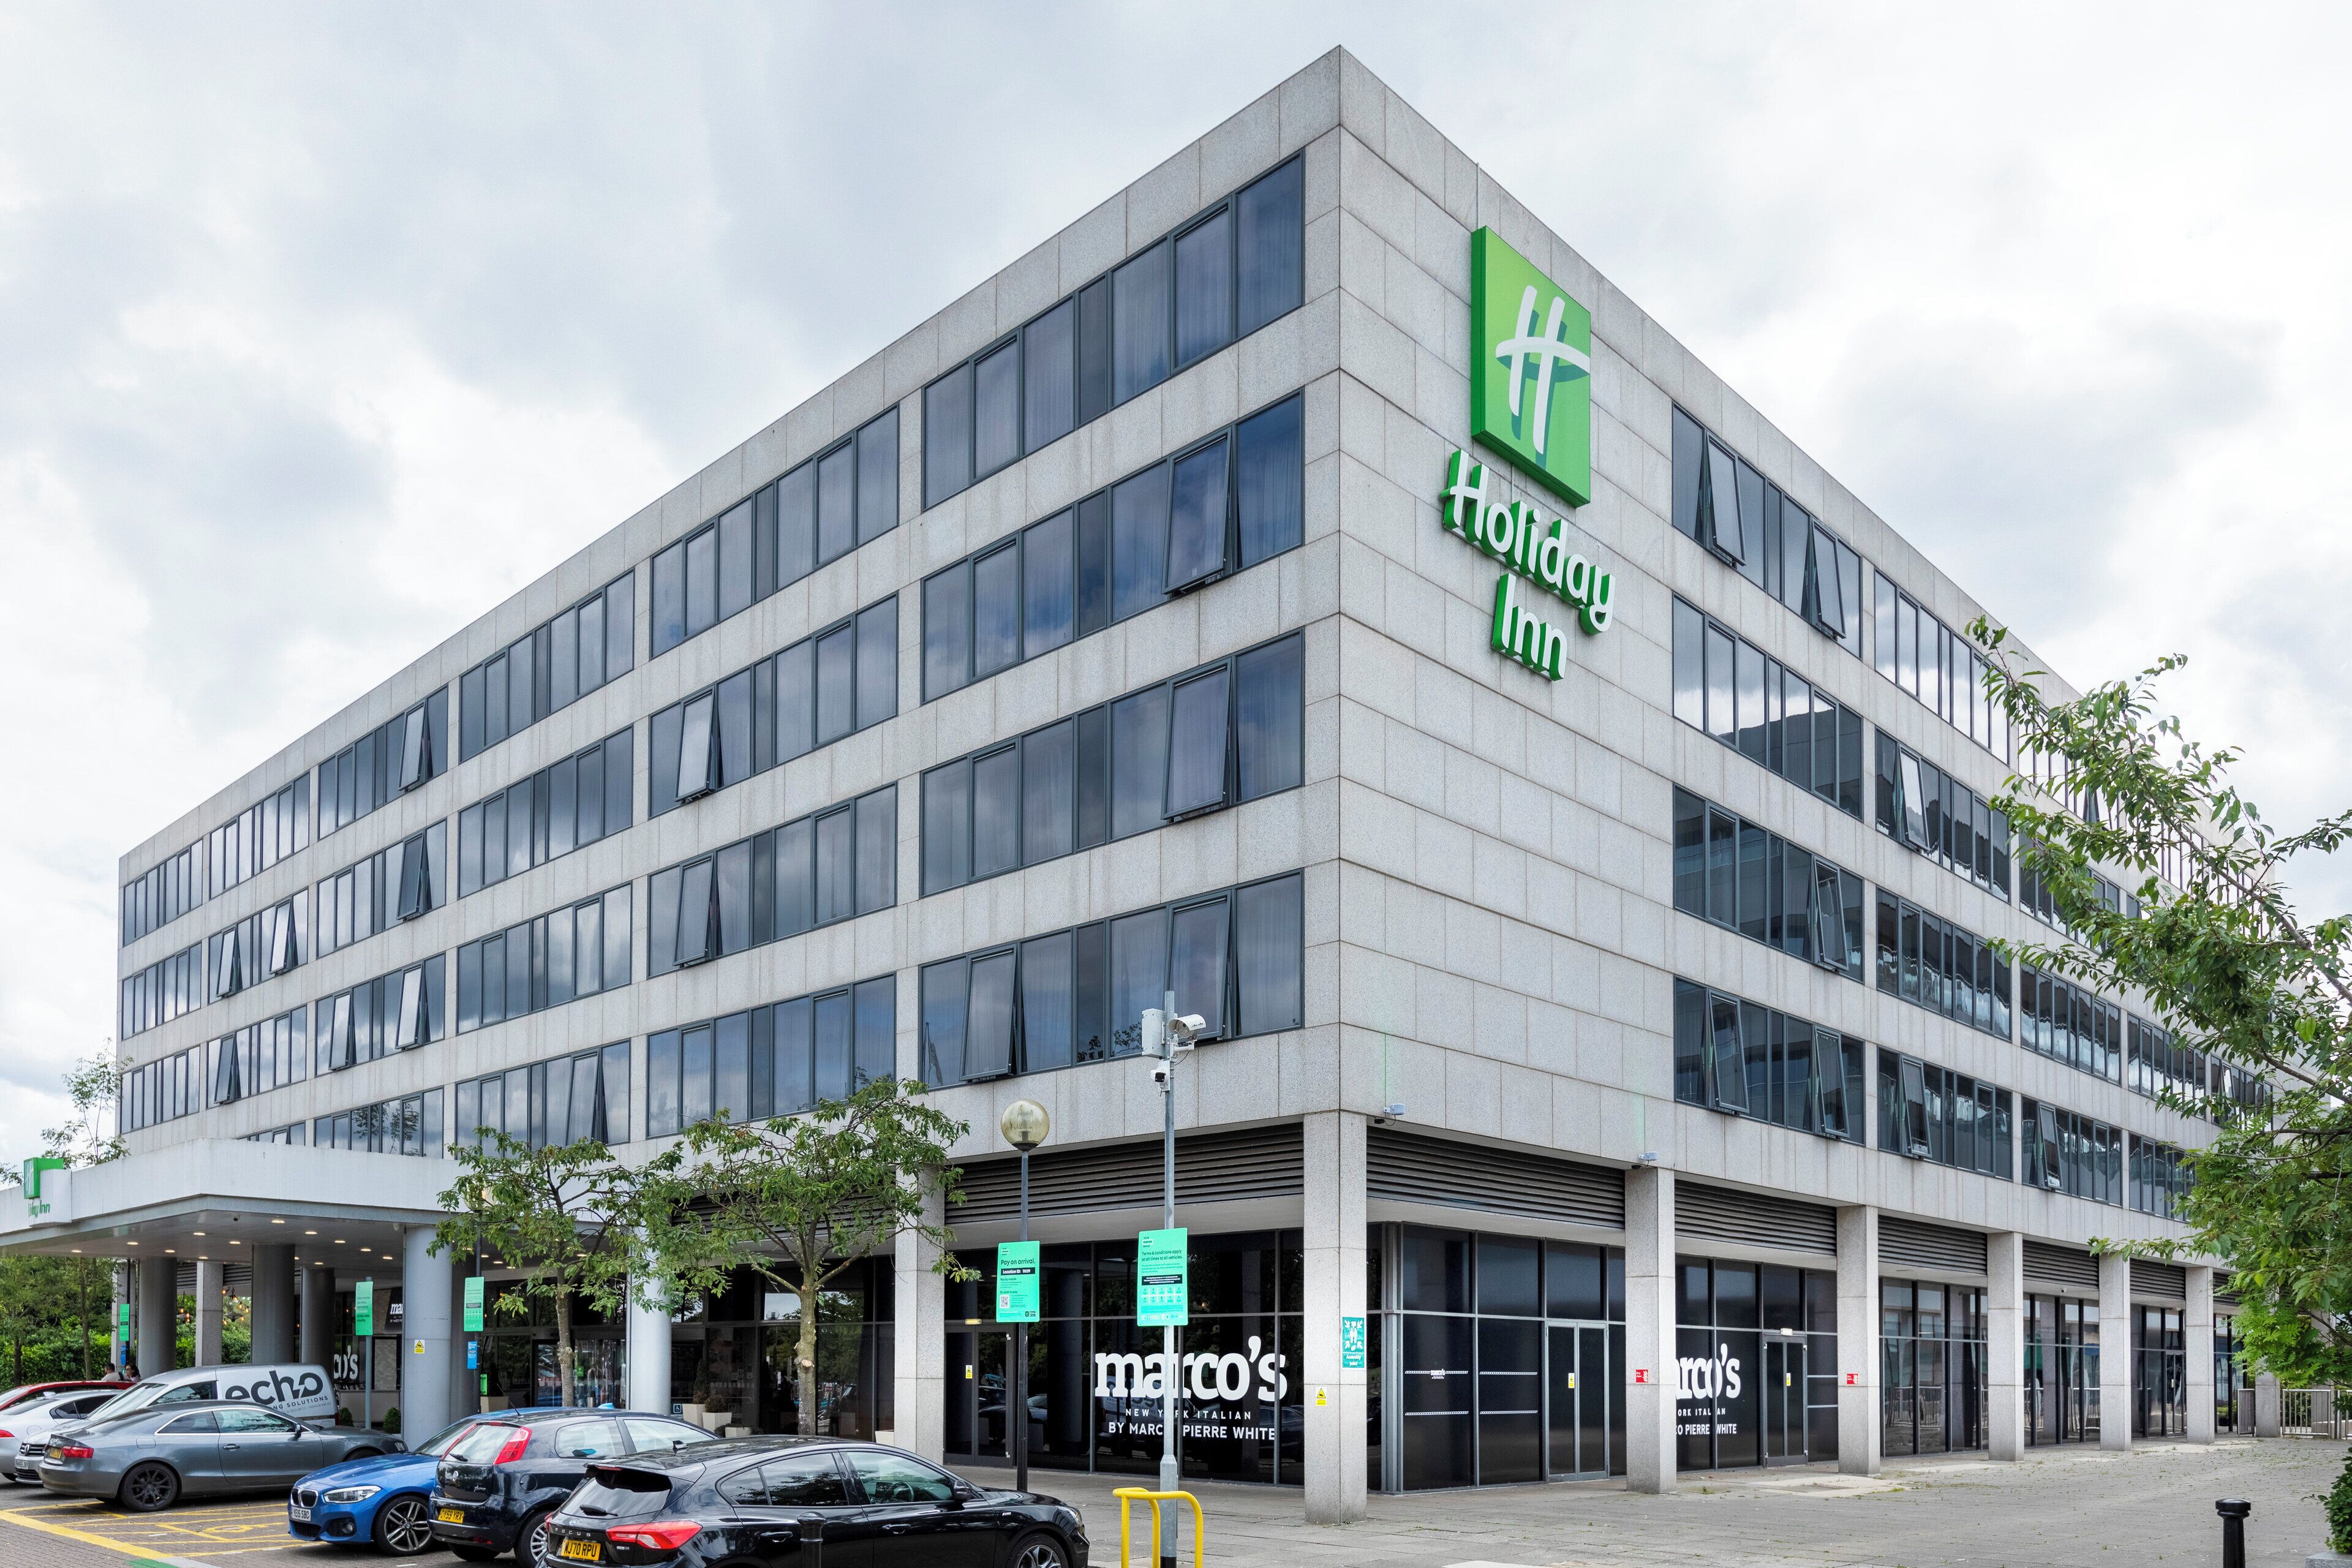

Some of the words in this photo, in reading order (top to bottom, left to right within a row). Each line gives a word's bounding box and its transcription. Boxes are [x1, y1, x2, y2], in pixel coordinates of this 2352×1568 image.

[1441, 448, 1616, 634] Holiday
[1492, 572, 1567, 681] Inn
[39, 1200, 50, 1214] Inn
[1095, 1336, 1287, 1401] marco's
[287, 1395, 328, 1408] SOLUTIONS
[1197, 1411, 1251, 1420] ITALIAN
[1109, 1422, 1125, 1433] BY
[1183, 1425, 1227, 1438] PIERRE
[1233, 1427, 1275, 1440] WHITE
[1685, 1424, 1710, 1435] PIERRE
[1716, 1423, 1737, 1434] WHITE
[555, 1528, 591, 1537] FOCUS
[581, 1543, 597, 1558] RPU
